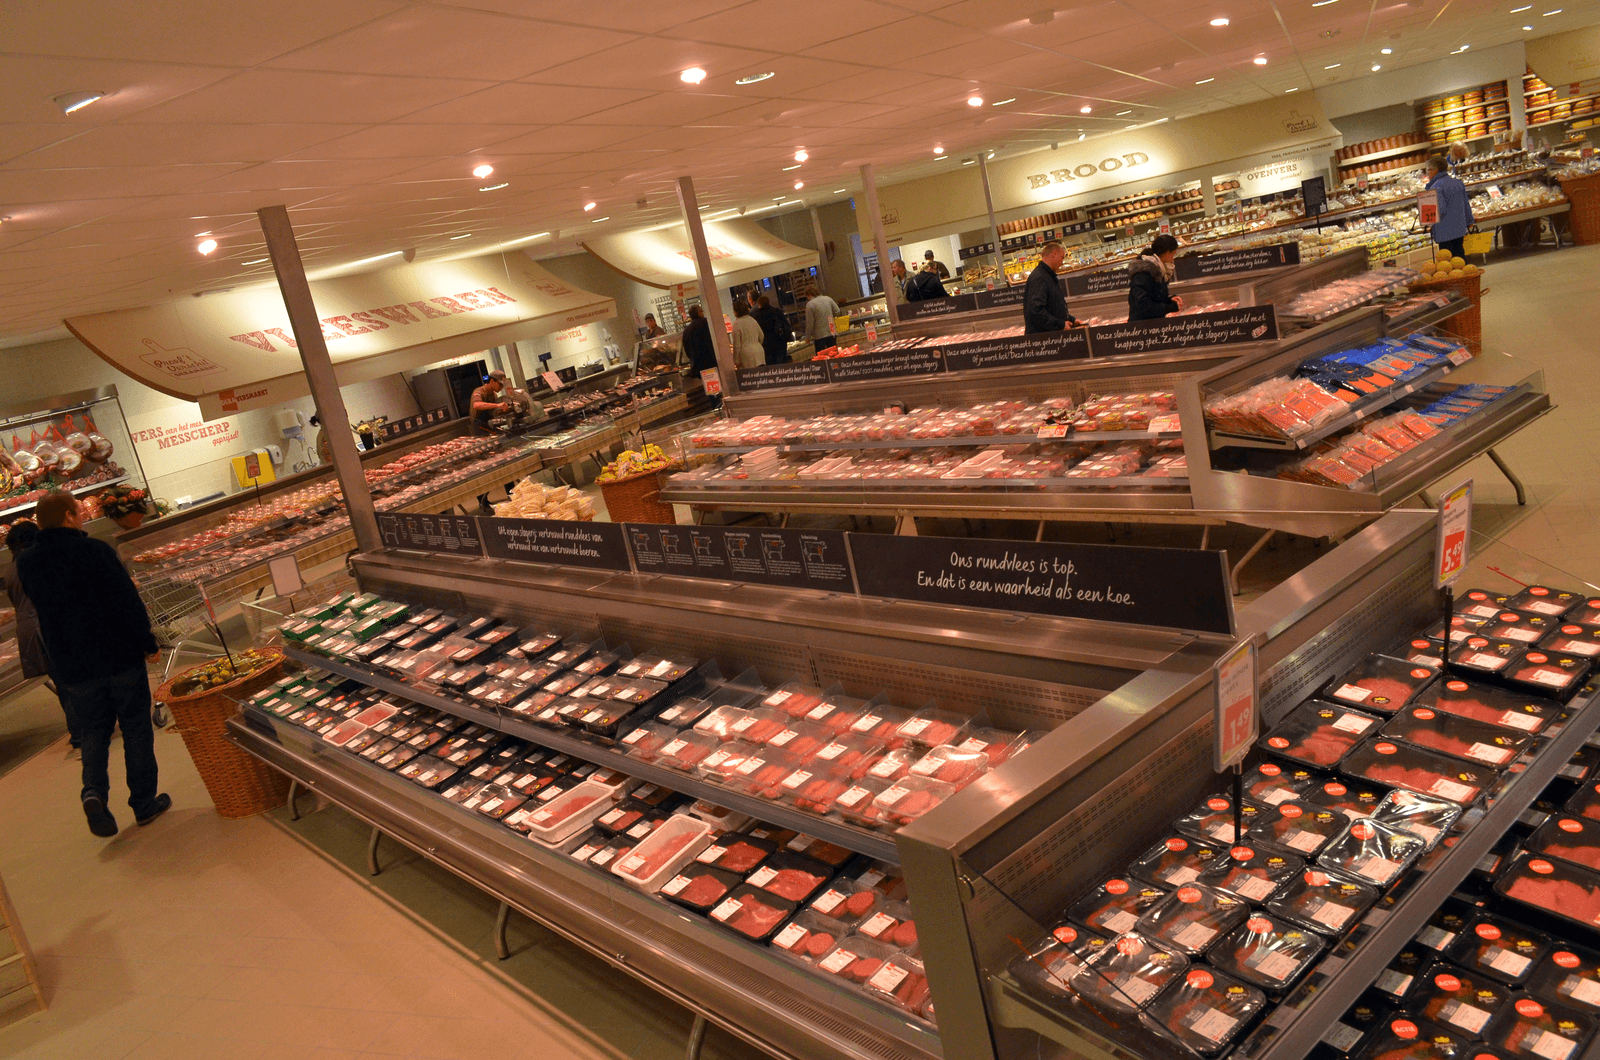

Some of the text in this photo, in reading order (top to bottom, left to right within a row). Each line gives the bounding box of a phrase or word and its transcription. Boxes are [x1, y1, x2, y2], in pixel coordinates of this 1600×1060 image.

[1027, 152, 1149, 189] BROOD
[1247, 164, 1298, 181] OVENVERS
[229, 287, 517, 352] VLESWAREN
[1096, 331, 1113, 341] Onze
[1149, 327, 1161, 335] van
[1161, 320, 1185, 336] gekruid
[1213, 313, 1250, 327] omwikkeld
[1251, 313, 1266, 322] met
[1114, 337, 1144, 350] knapperig
[1162, 335, 1172, 344] Ze
[1173, 332, 1195, 346] vliegen
[1196, 331, 1204, 340] de
[1205, 327, 1229, 343] slagerij
[130, 427, 164, 443] VERS
[178, 423, 188, 431] het
[157, 422, 230, 450] MESSCHERP
[212, 430, 239, 447] geprijsd!
[1444, 540, 1463, 572] 5.49
[950, 551, 1078, 582] Ons rundvlees is top.
[917, 569, 1135, 605] En dat is een waarheid als een koe.
[1478, 928, 1500, 936] ACTIE
[1556, 956, 1579, 965] ACTIE
[1190, 976, 1211, 984] ACTIE
[1438, 979, 1459, 987] ACTIE
[1518, 1004, 1542, 1014] ACTIE
[1394, 1025, 1417, 1033] ACTIE
